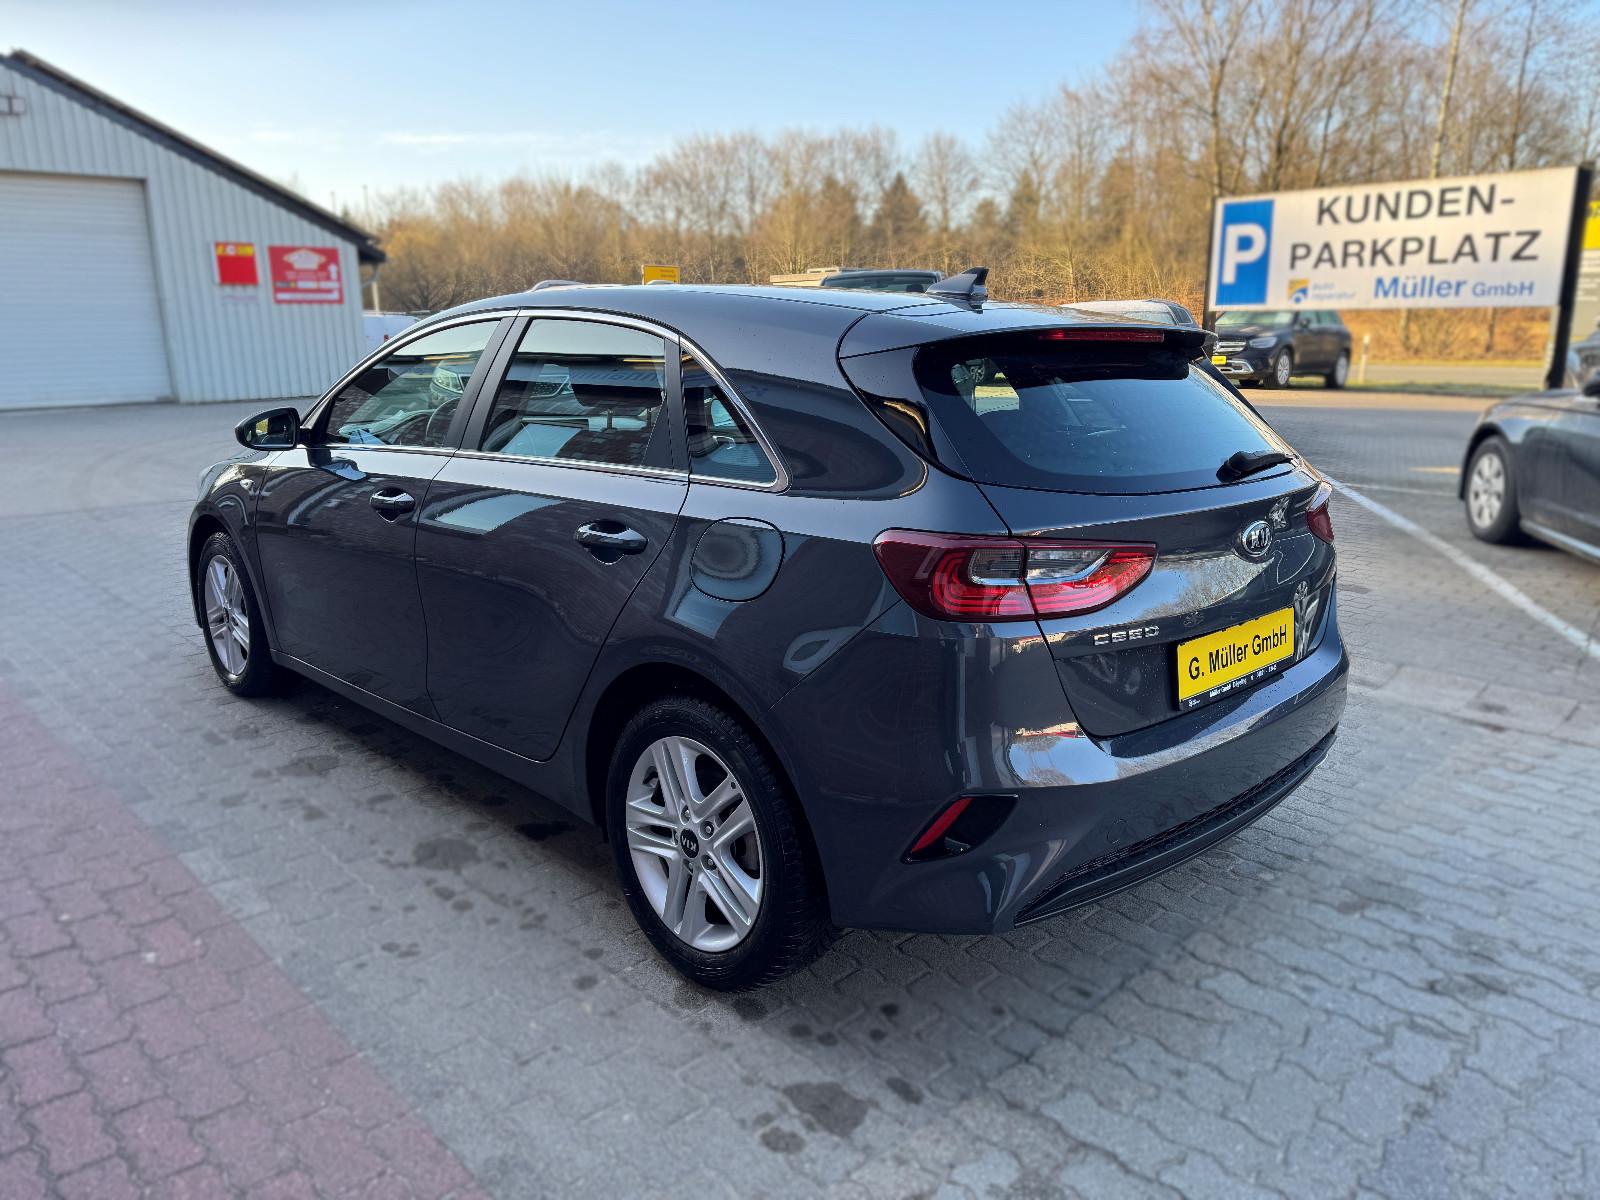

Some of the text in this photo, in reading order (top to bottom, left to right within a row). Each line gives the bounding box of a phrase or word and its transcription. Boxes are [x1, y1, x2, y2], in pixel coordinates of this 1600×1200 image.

[1316, 184, 1516, 226] KUNDEN-
[1221, 223, 1267, 285] P
[1289, 230, 1542, 270] PARKPLATZ
[1373, 275, 1535, 299] Müller GmbH
[1188, 656, 1204, 680] G.
[1209, 643, 1248, 673] Müller
[1251, 624, 1288, 655] GmbH
